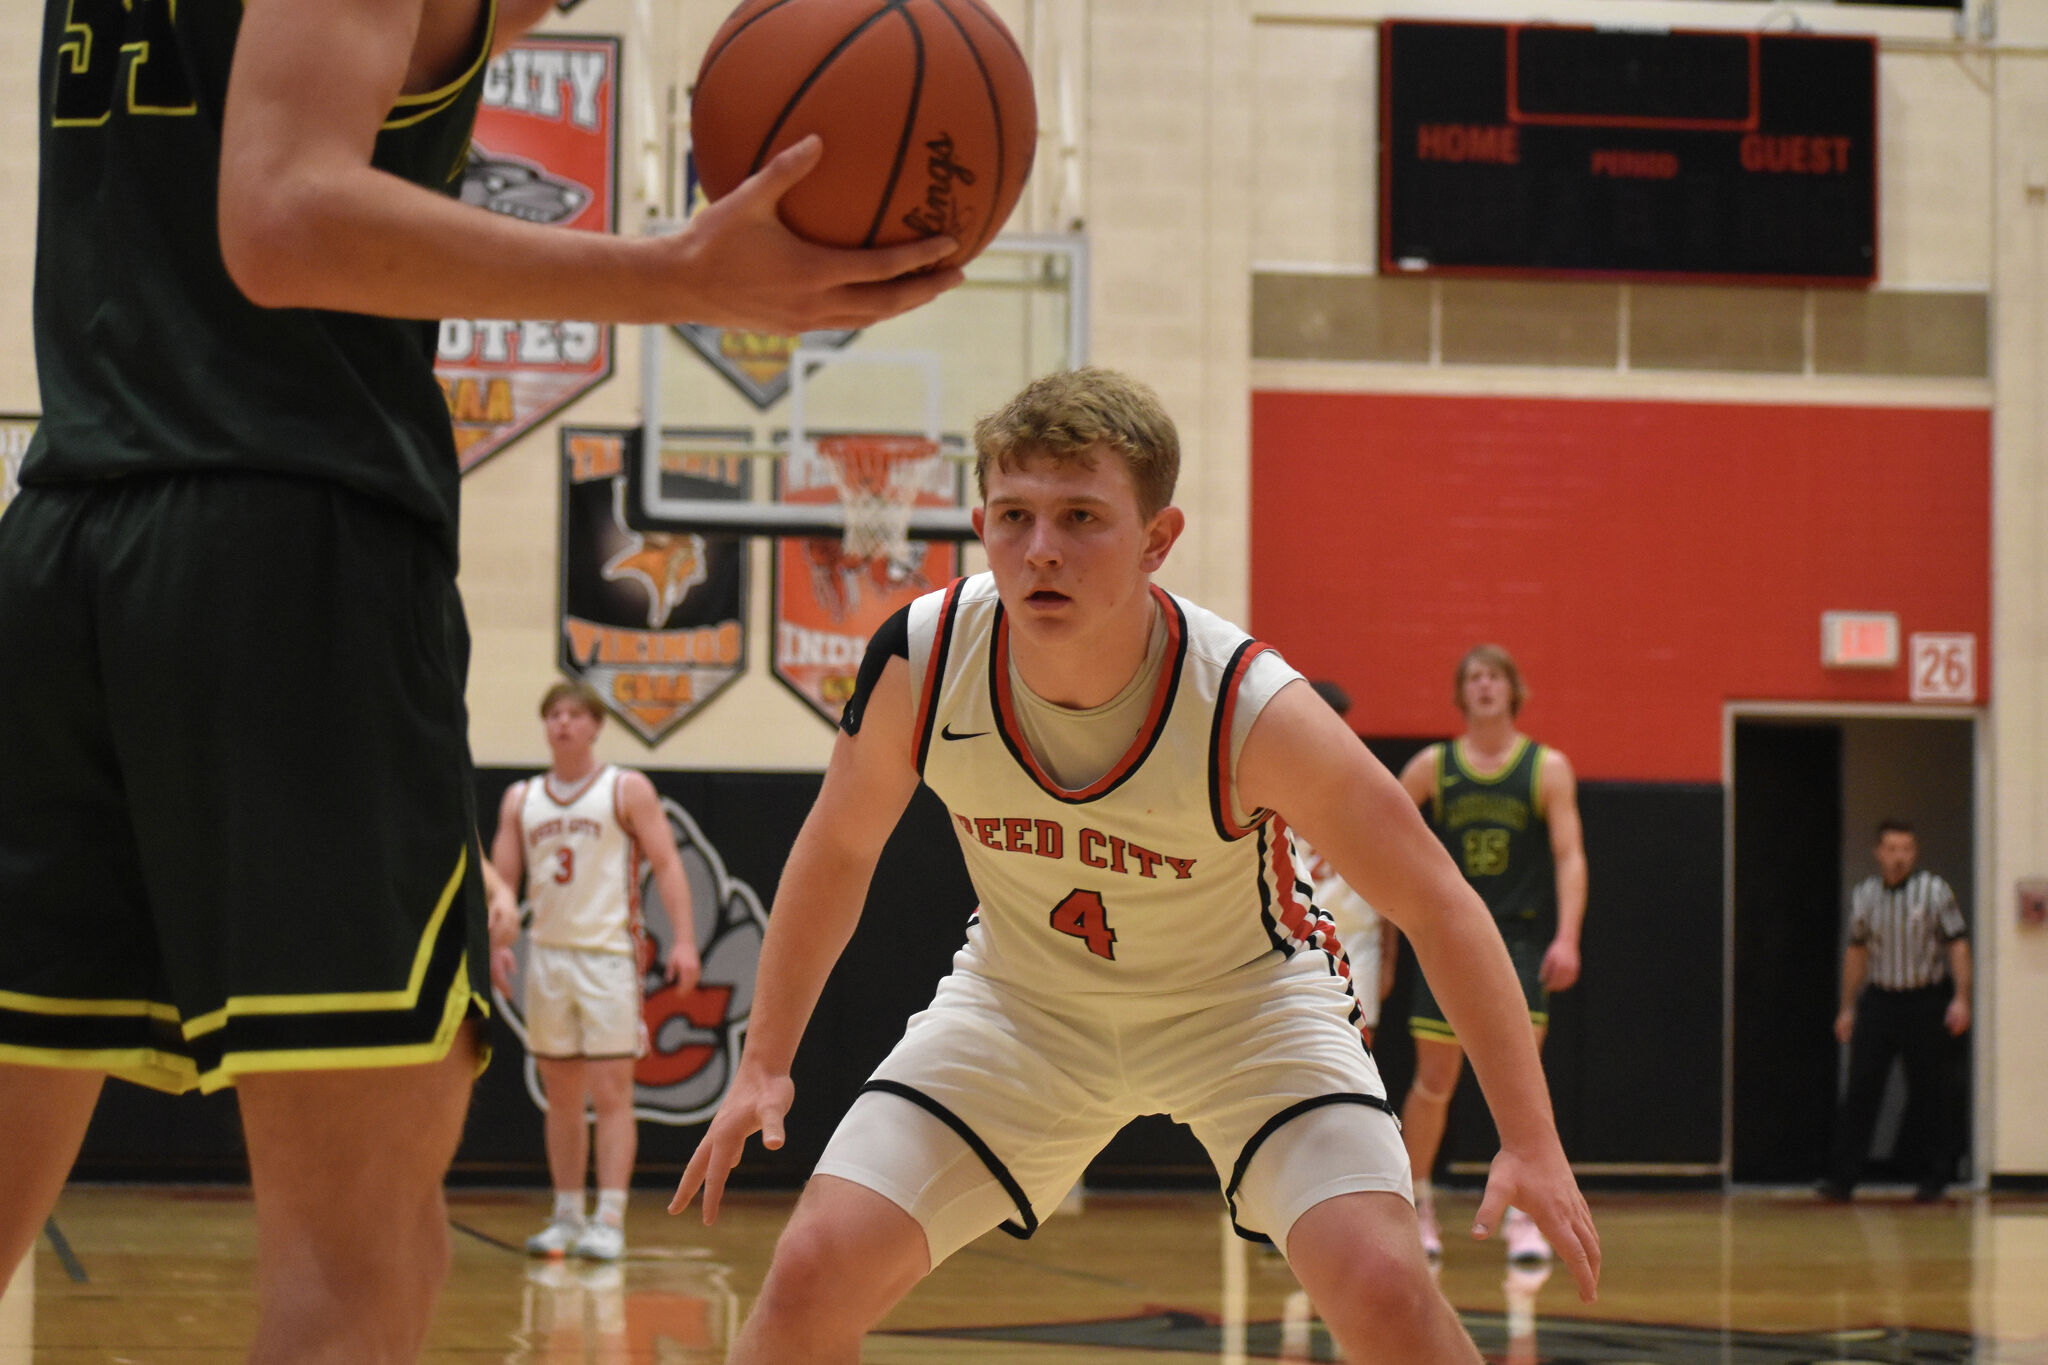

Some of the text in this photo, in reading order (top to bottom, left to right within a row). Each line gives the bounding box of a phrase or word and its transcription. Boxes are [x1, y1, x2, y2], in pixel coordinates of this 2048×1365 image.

[483, 50, 606, 129] CITY
[1417, 124, 1519, 164] HOME
[1740, 134, 1851, 174] GUEST
[902, 131, 977, 236] lings
[438, 318, 600, 364] OTES
[1920, 645, 1965, 689] 26
[552, 846, 575, 885] 3
[1079, 827, 1197, 880] CITY
[1050, 887, 1118, 961] 4
